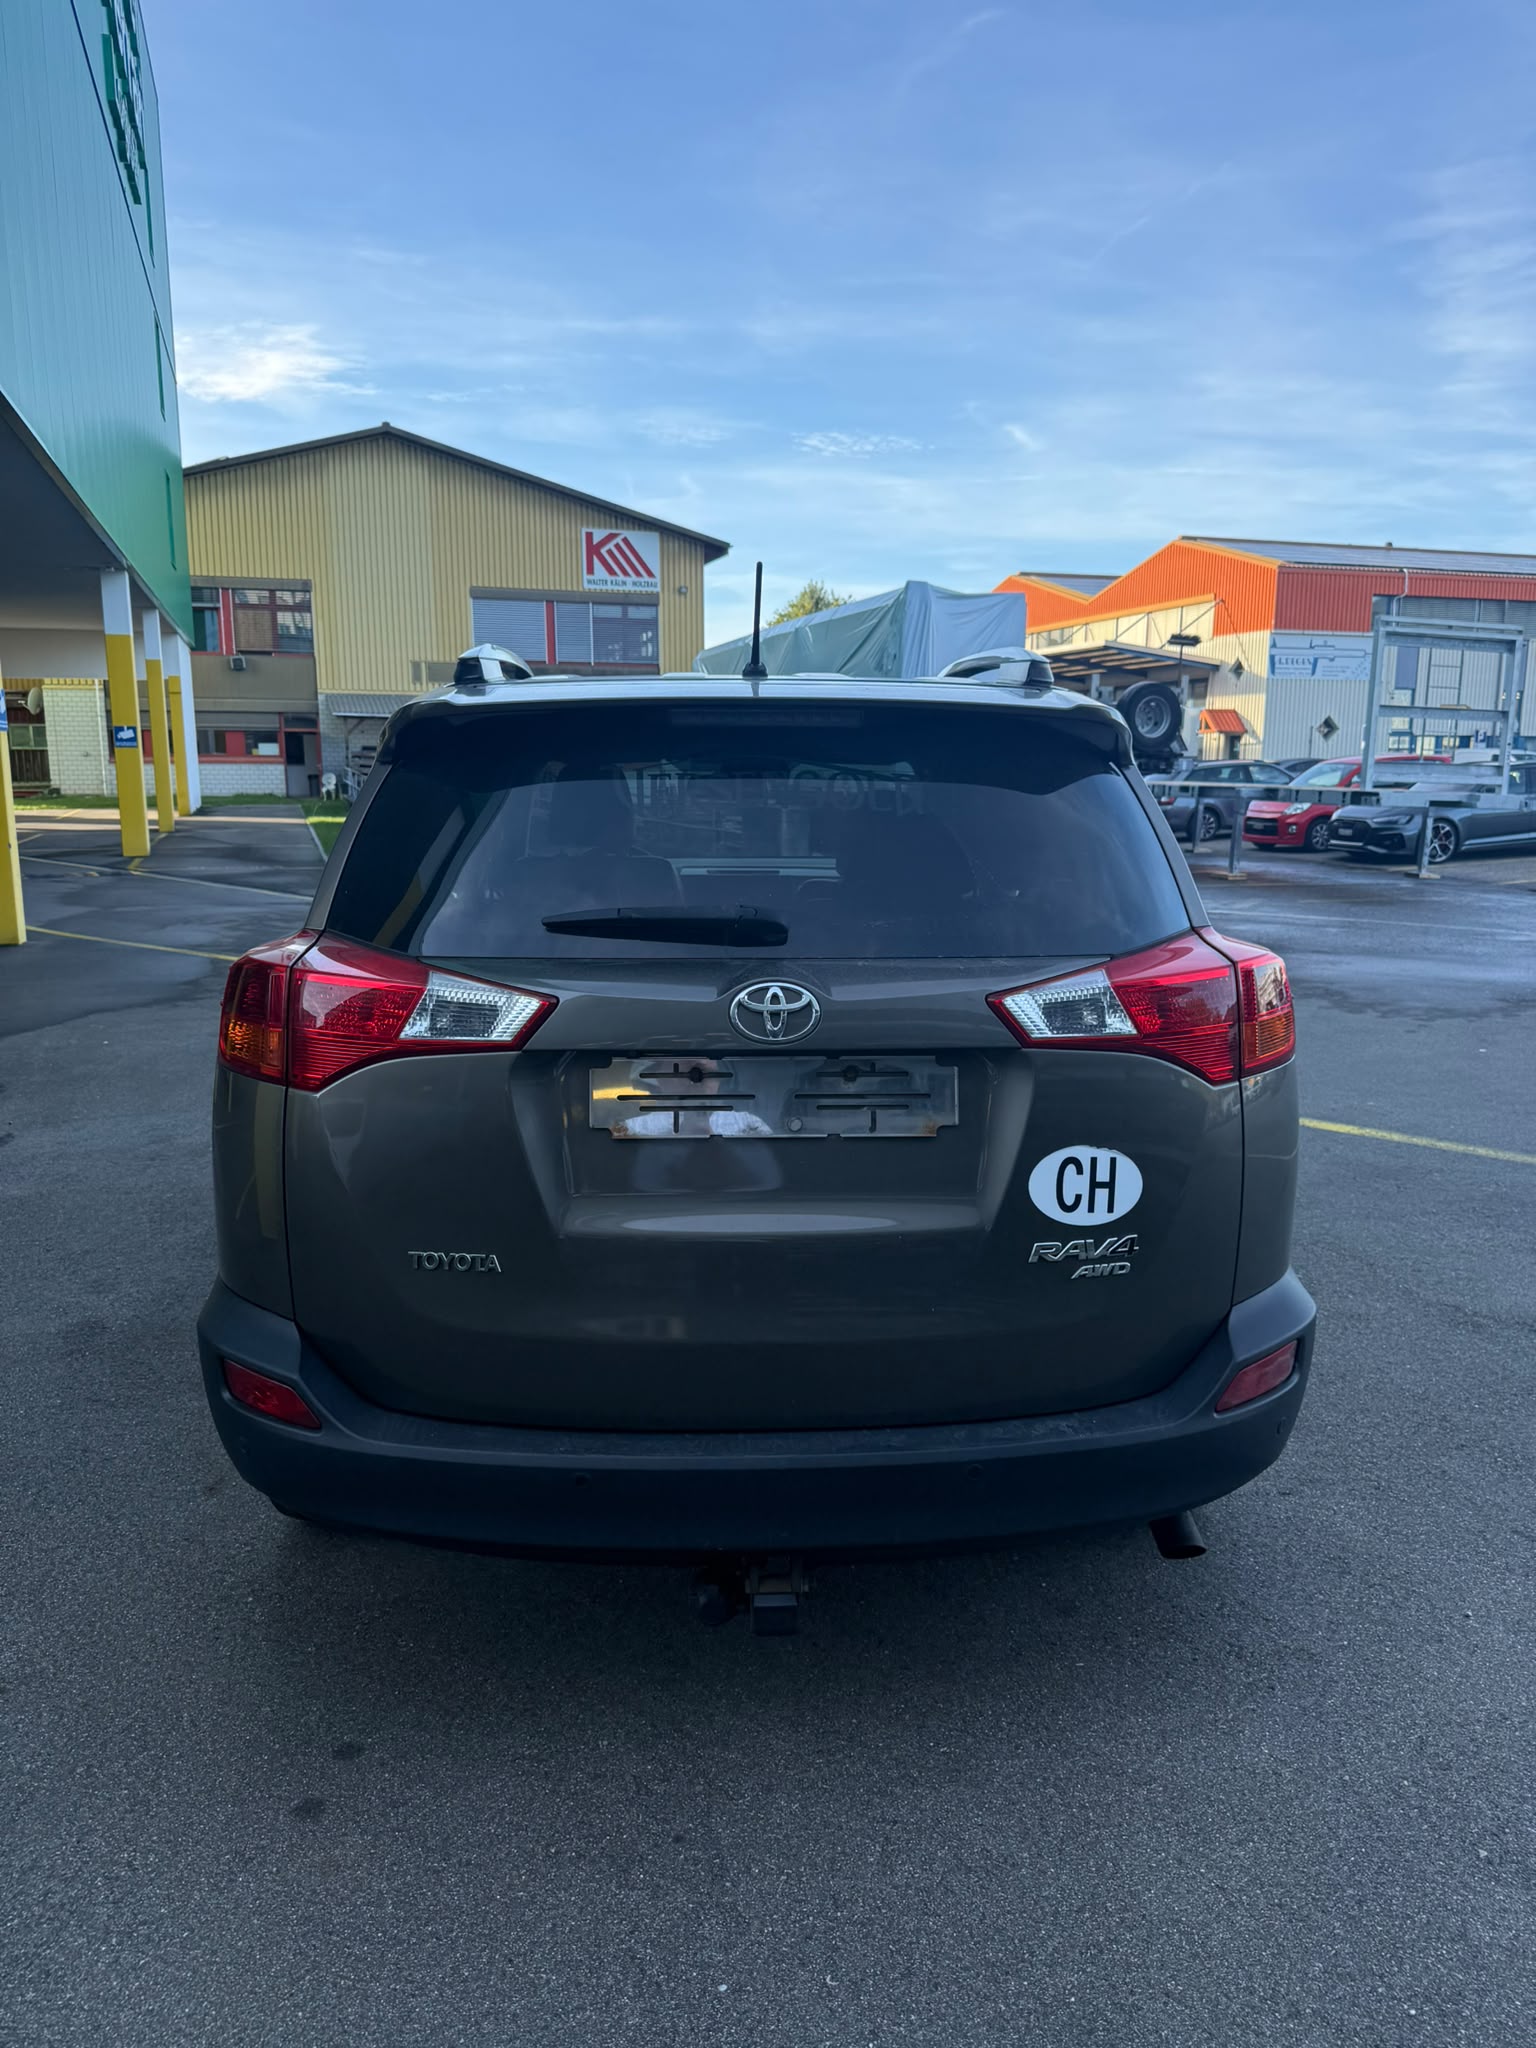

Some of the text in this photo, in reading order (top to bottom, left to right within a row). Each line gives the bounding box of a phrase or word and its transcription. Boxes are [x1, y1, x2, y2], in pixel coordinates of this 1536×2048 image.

[1055, 1156, 1117, 1214] CH
[1028, 1234, 1140, 1263] RAV4
[408, 1251, 502, 1272] TOYOTA
[1071, 1261, 1131, 1279] AWD
